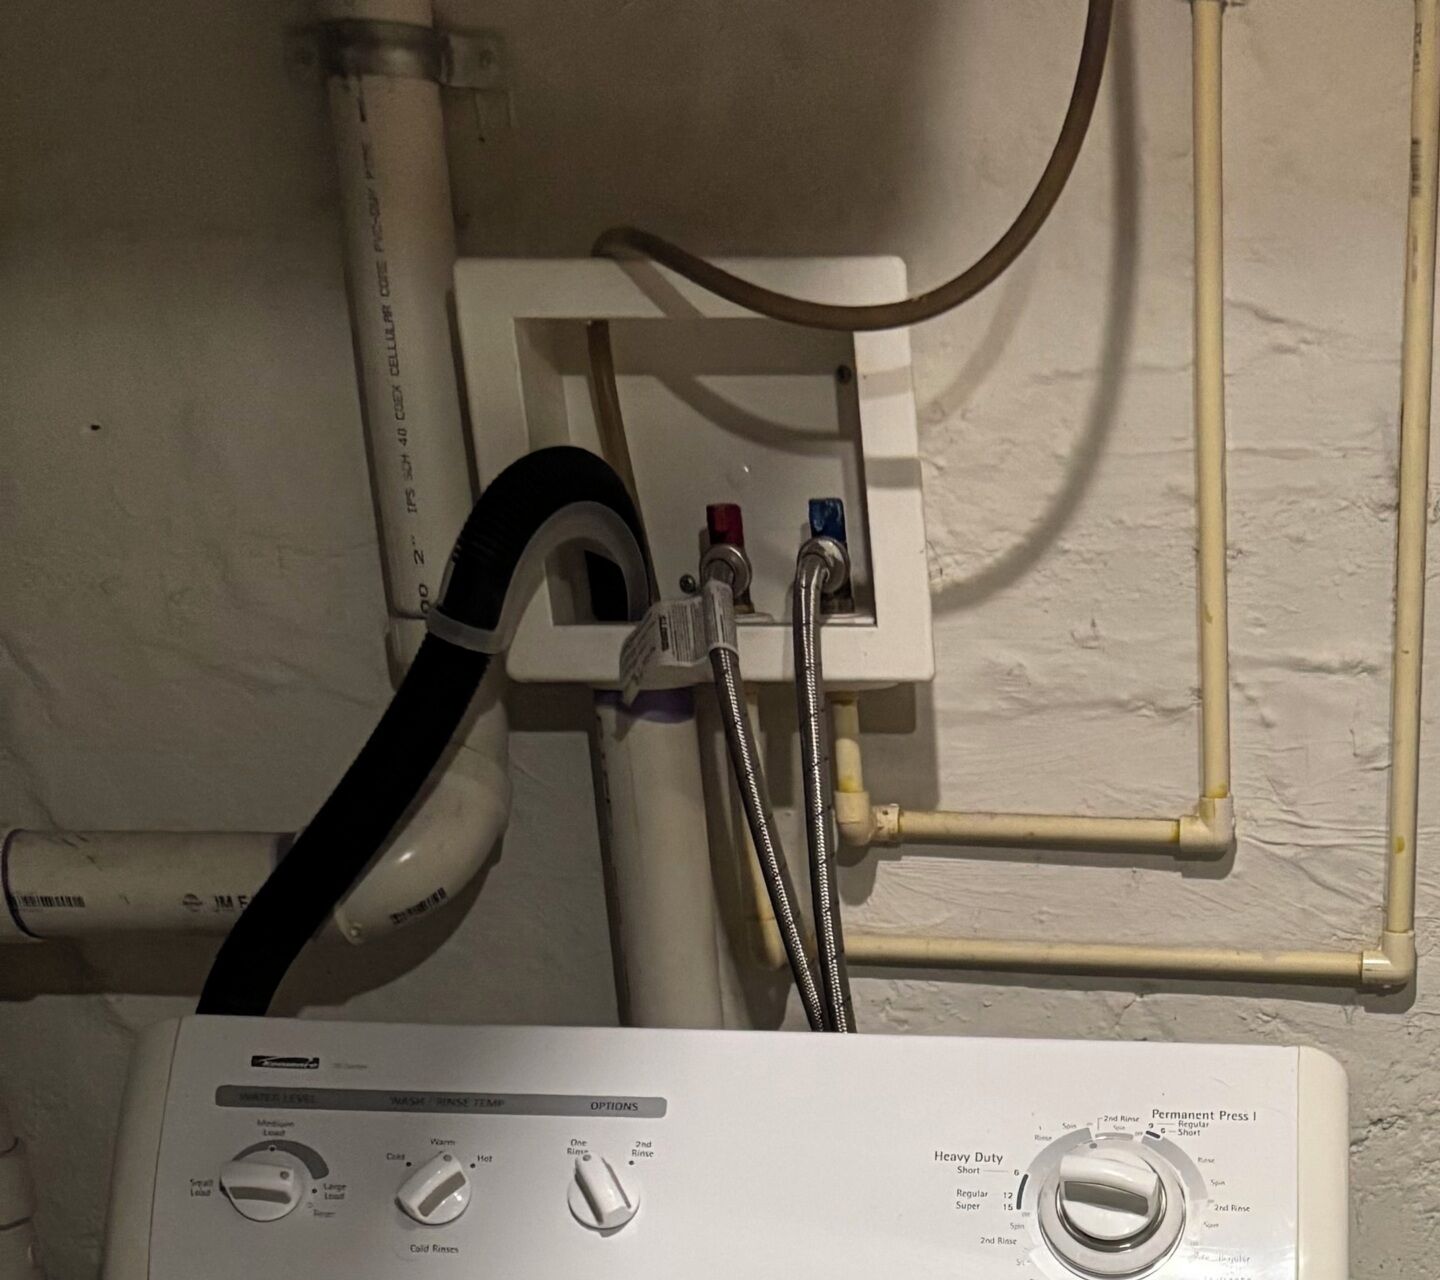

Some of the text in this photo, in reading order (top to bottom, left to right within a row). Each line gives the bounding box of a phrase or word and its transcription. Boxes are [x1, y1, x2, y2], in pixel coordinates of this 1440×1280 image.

[589, 1101, 639, 1112] OPTIONS
[1103, 1114, 1139, 1123] 2nd Rinse
[1152, 1109, 1215, 1121] Permanent
[1219, 1110, 1249, 1122] Press
[1178, 1120, 1210, 1130] Regular
[1177, 1128, 1201, 1137] Short
[430, 1138, 456, 1147] Warm
[570, 1138, 588, 1147] One
[635, 1139, 652, 1148] 2nd
[631, 1148, 654, 1158] Rinse
[934, 1150, 1004, 1165] Heavy Duty
[477, 1155, 493, 1163] Hot
[957, 1166, 981, 1175] Short
[956, 1188, 1013, 1200] Regular 12
[955, 1201, 1014, 1212] Super 15
[1214, 1203, 1251, 1213] 2nd Rinse
[980, 1236, 1018, 1245] 2nd Rinse
[409, 1243, 460, 1255] Cold Rinses
